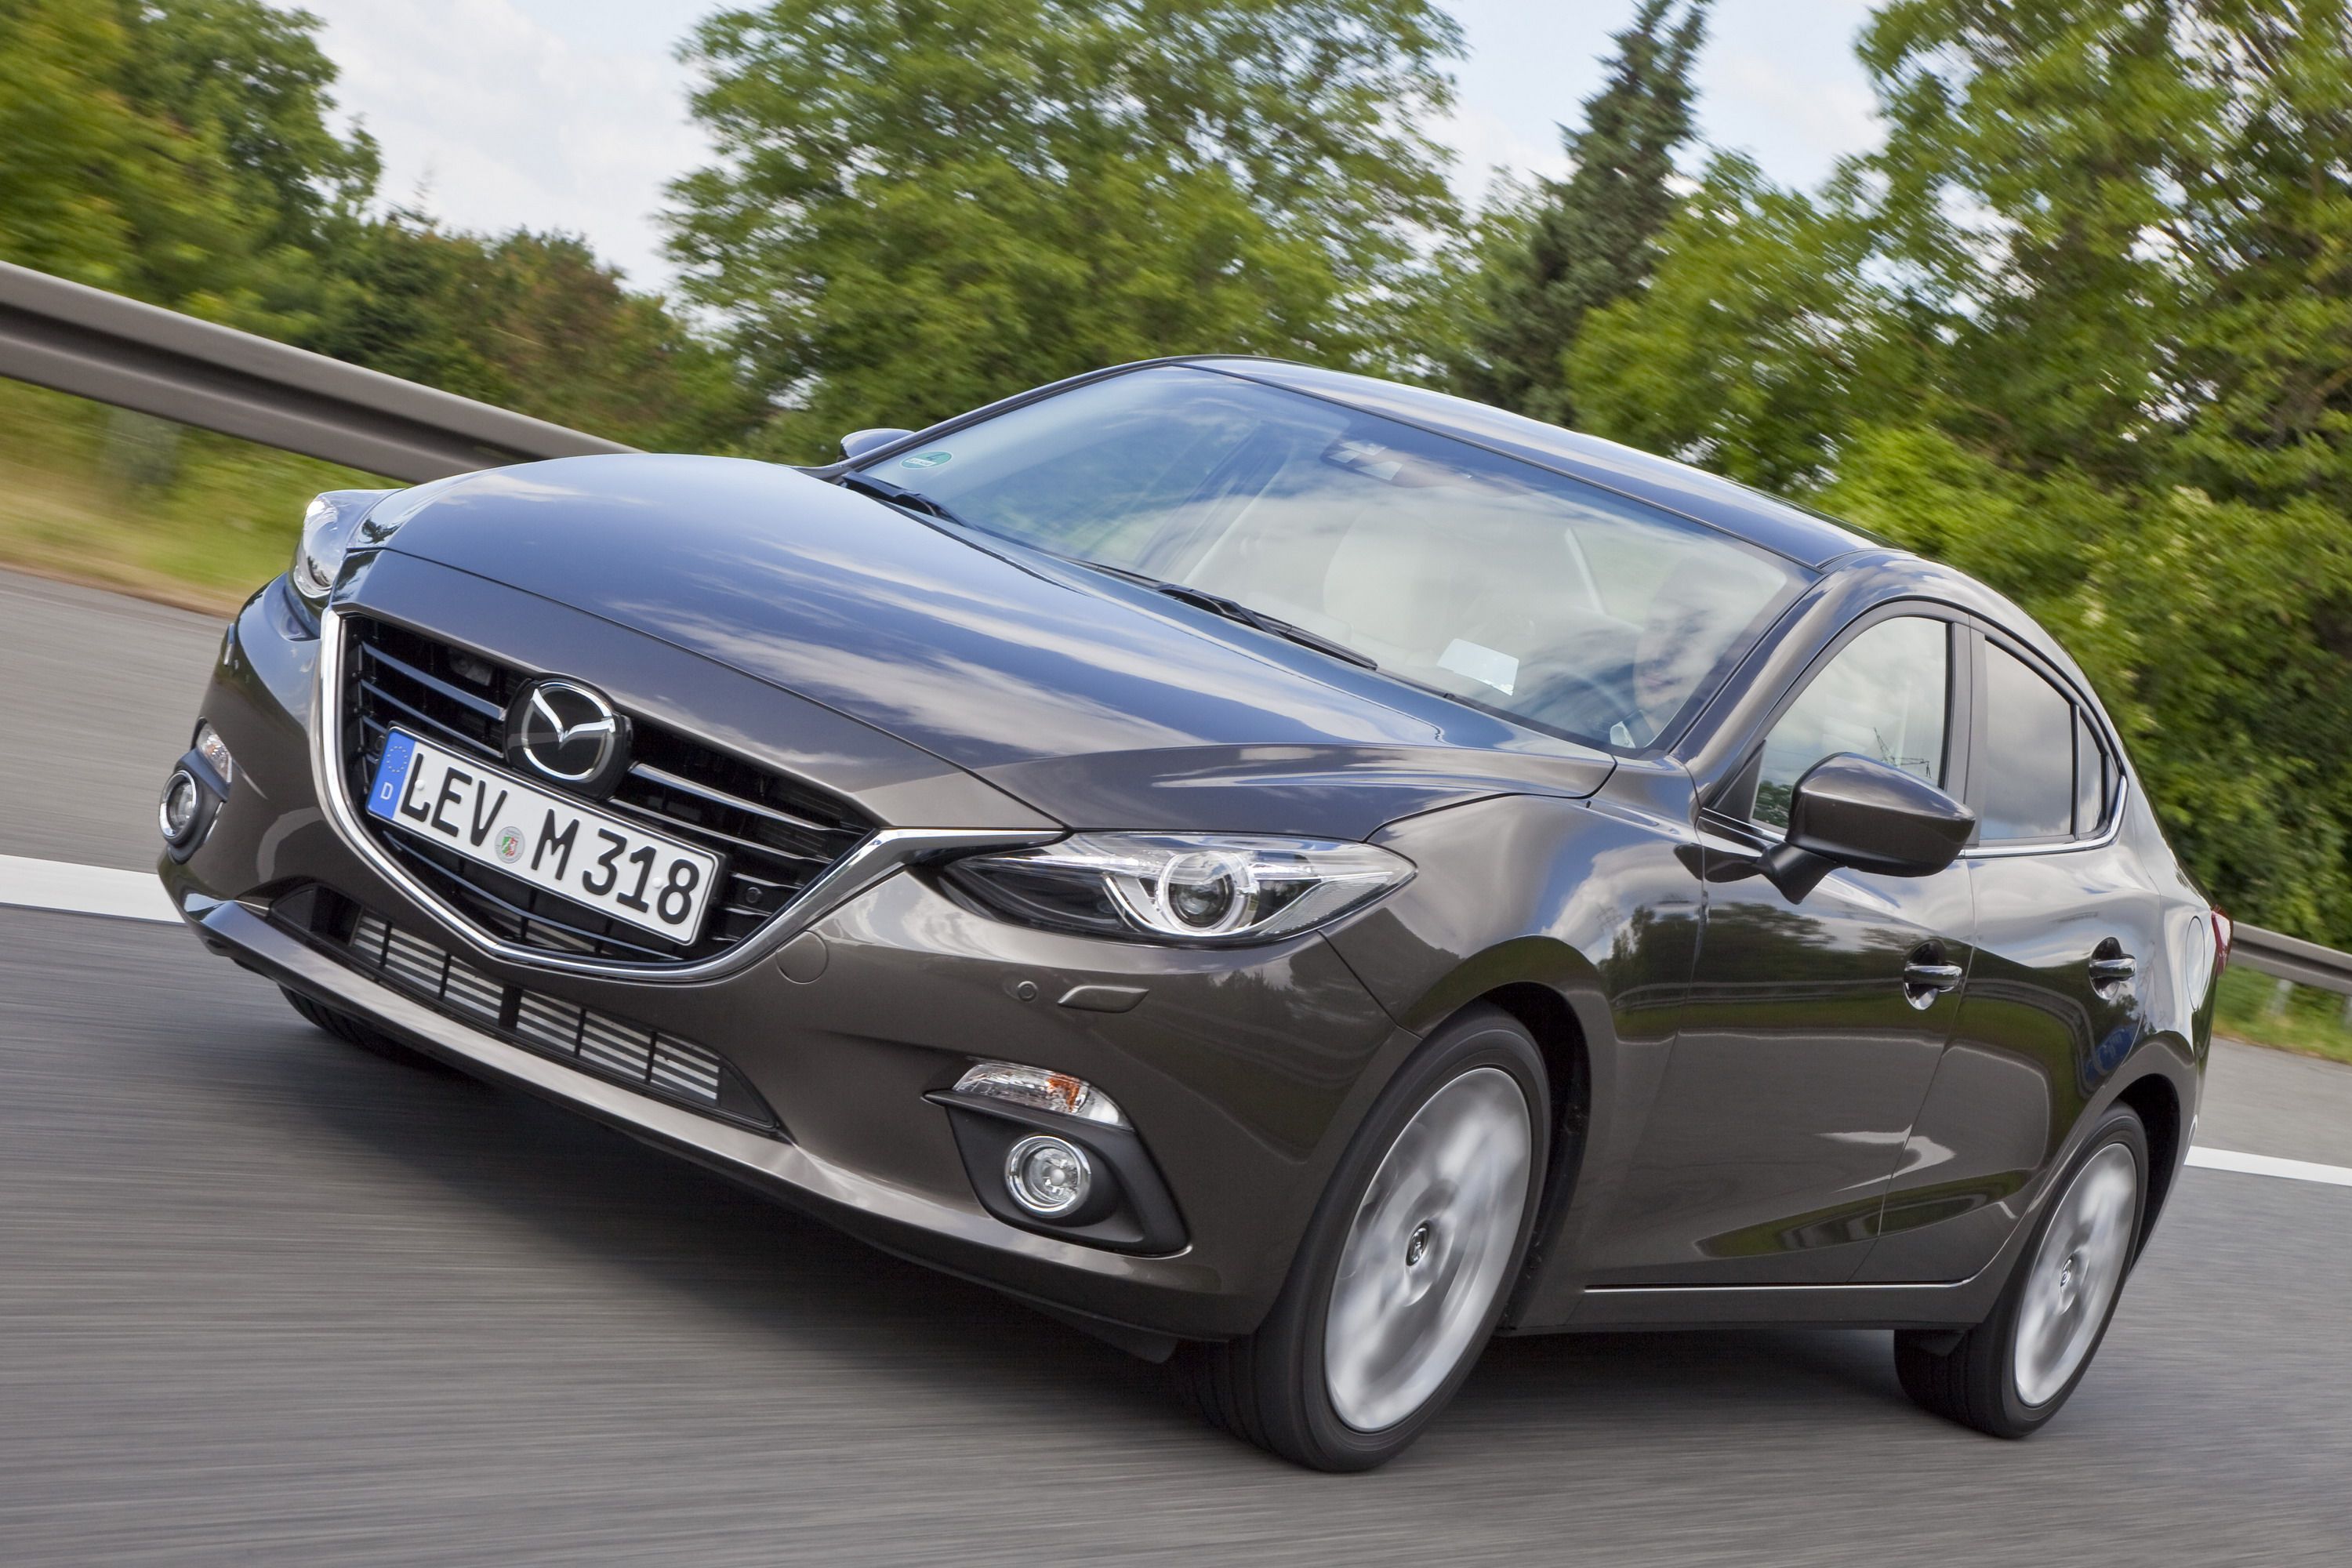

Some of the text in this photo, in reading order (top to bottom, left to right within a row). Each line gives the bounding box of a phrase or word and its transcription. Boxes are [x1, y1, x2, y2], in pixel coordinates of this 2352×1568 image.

[380, 782, 394, 800] D
[401, 753, 507, 847] LEV
[532, 809, 579, 880] M
[583, 829, 699, 925] 318
